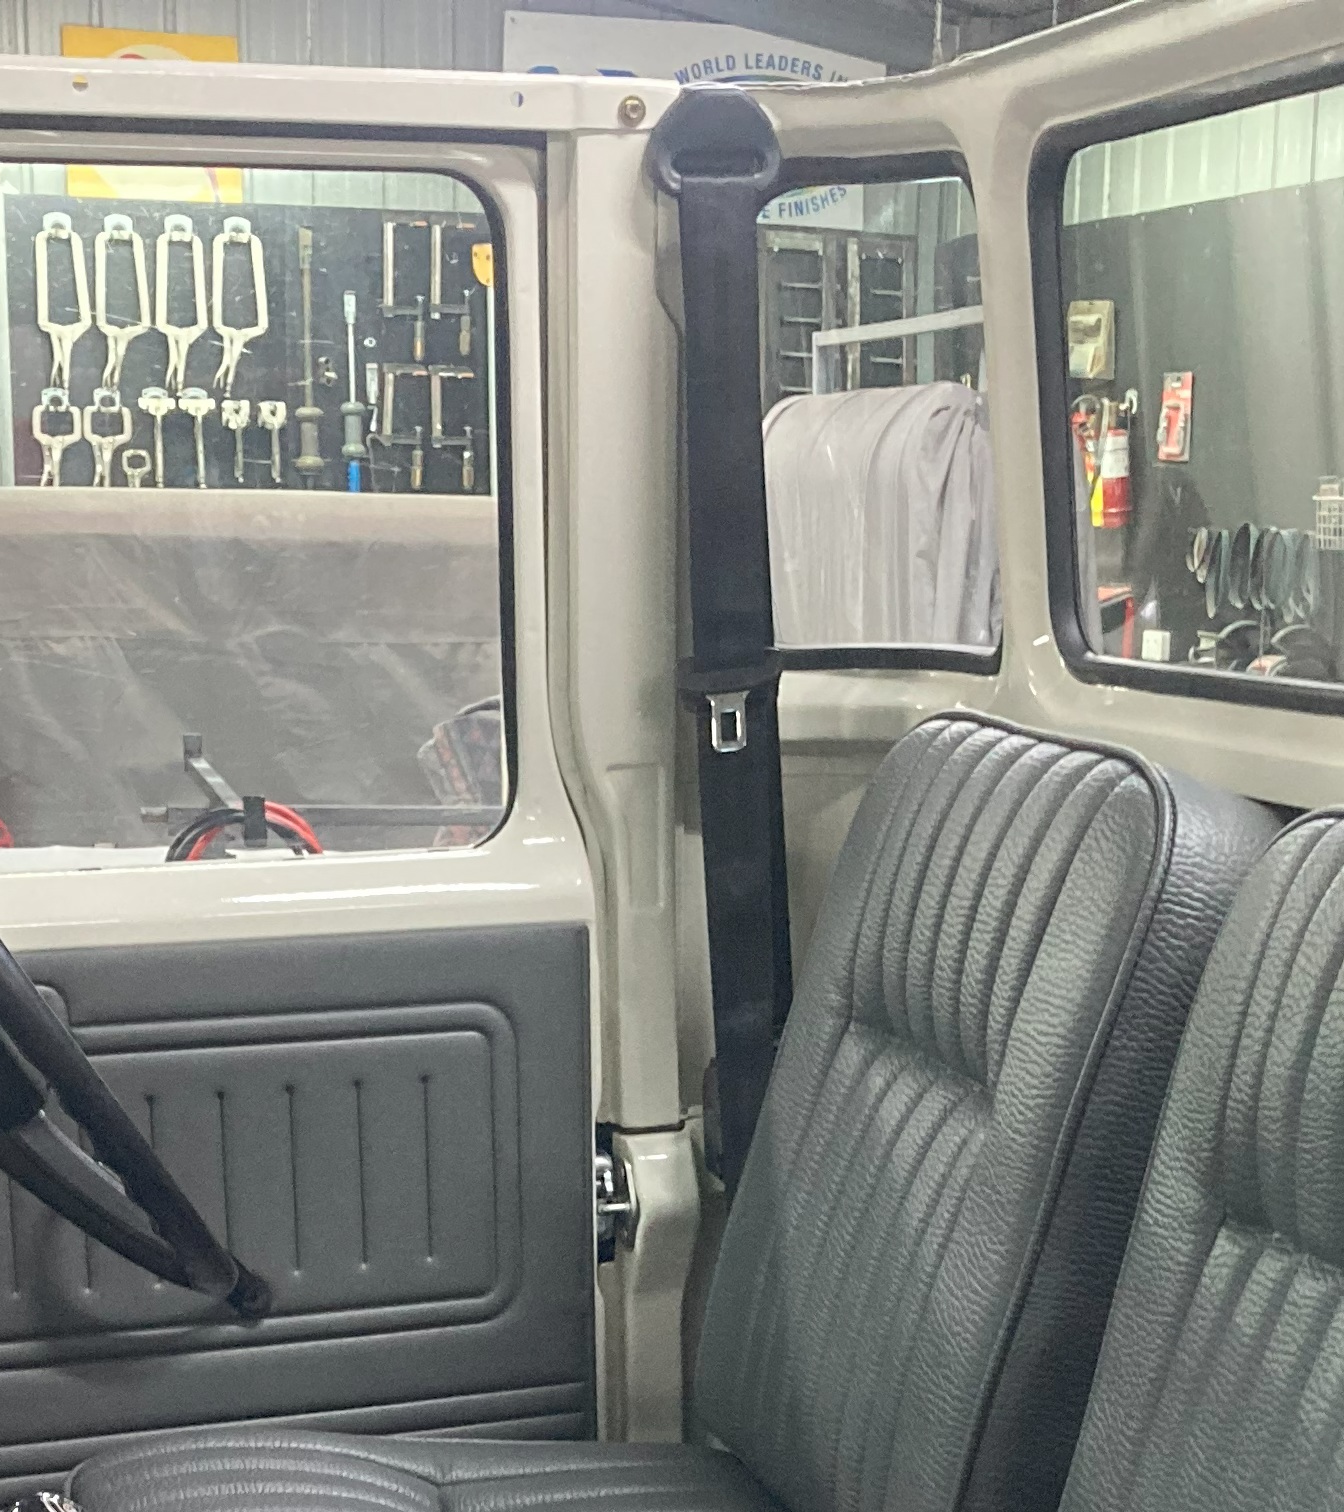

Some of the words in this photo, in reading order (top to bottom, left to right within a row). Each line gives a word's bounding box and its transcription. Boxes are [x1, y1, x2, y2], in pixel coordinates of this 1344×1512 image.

[674, 54, 737, 85] WORLD
[744, 53, 824, 81] LEADERS
[777, 186, 847, 219] FINISHES
